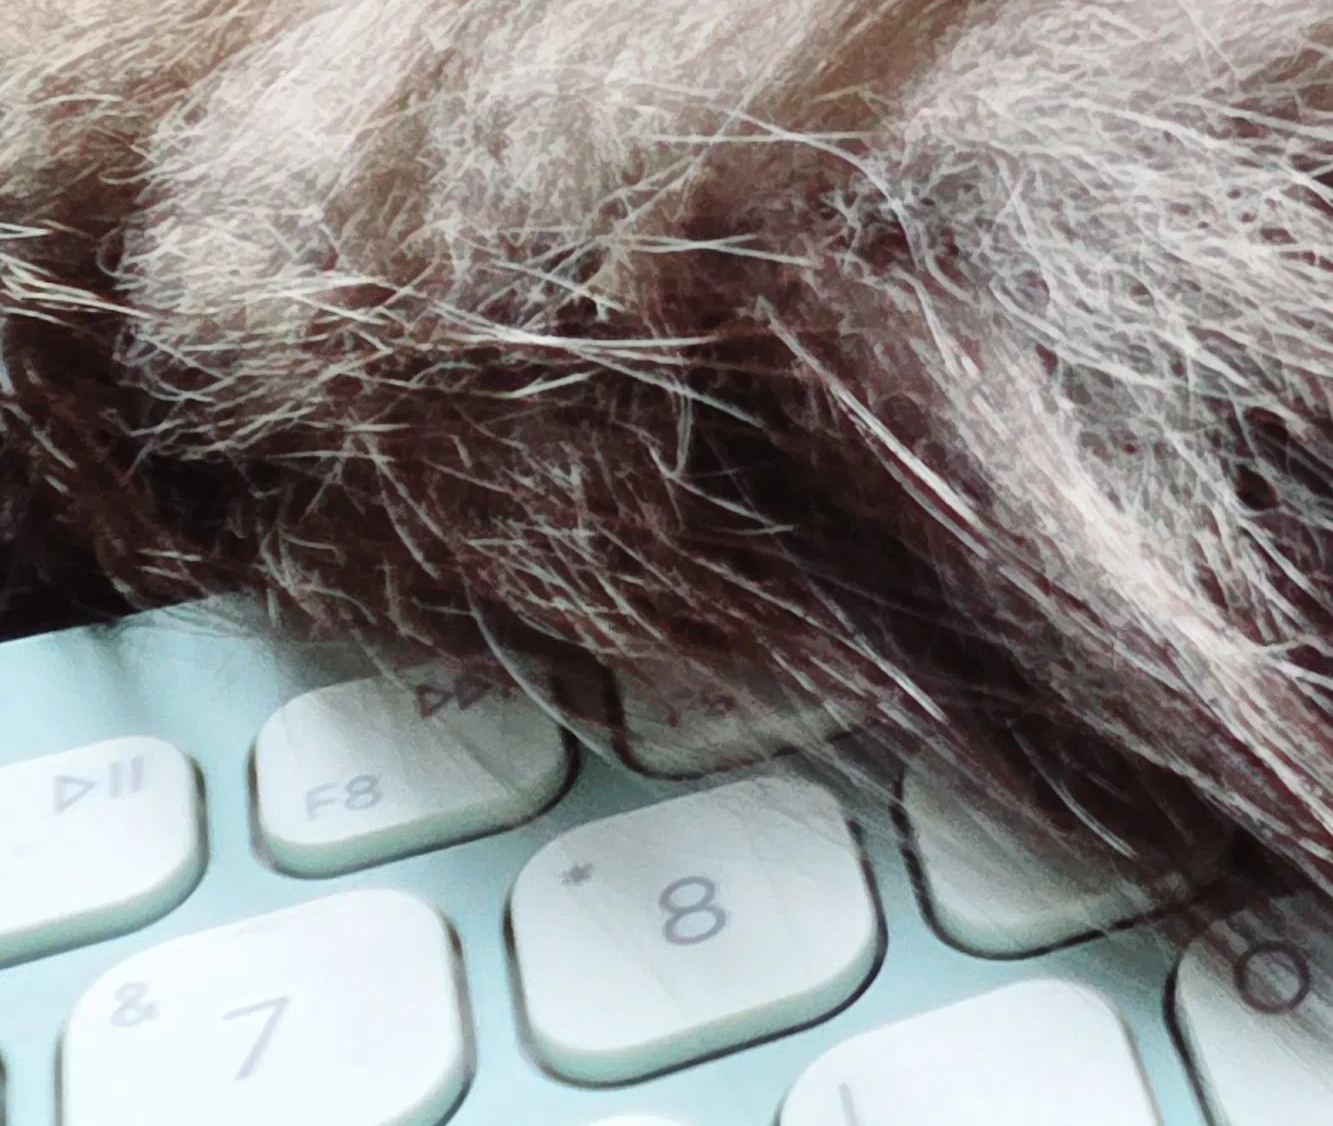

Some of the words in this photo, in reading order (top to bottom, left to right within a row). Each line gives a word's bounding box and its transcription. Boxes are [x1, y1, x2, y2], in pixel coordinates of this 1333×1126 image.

[305, 774, 382, 822] F8
[659, 875, 726, 945] 8
[111, 981, 160, 1028] &
[221, 995, 292, 1081] 7
